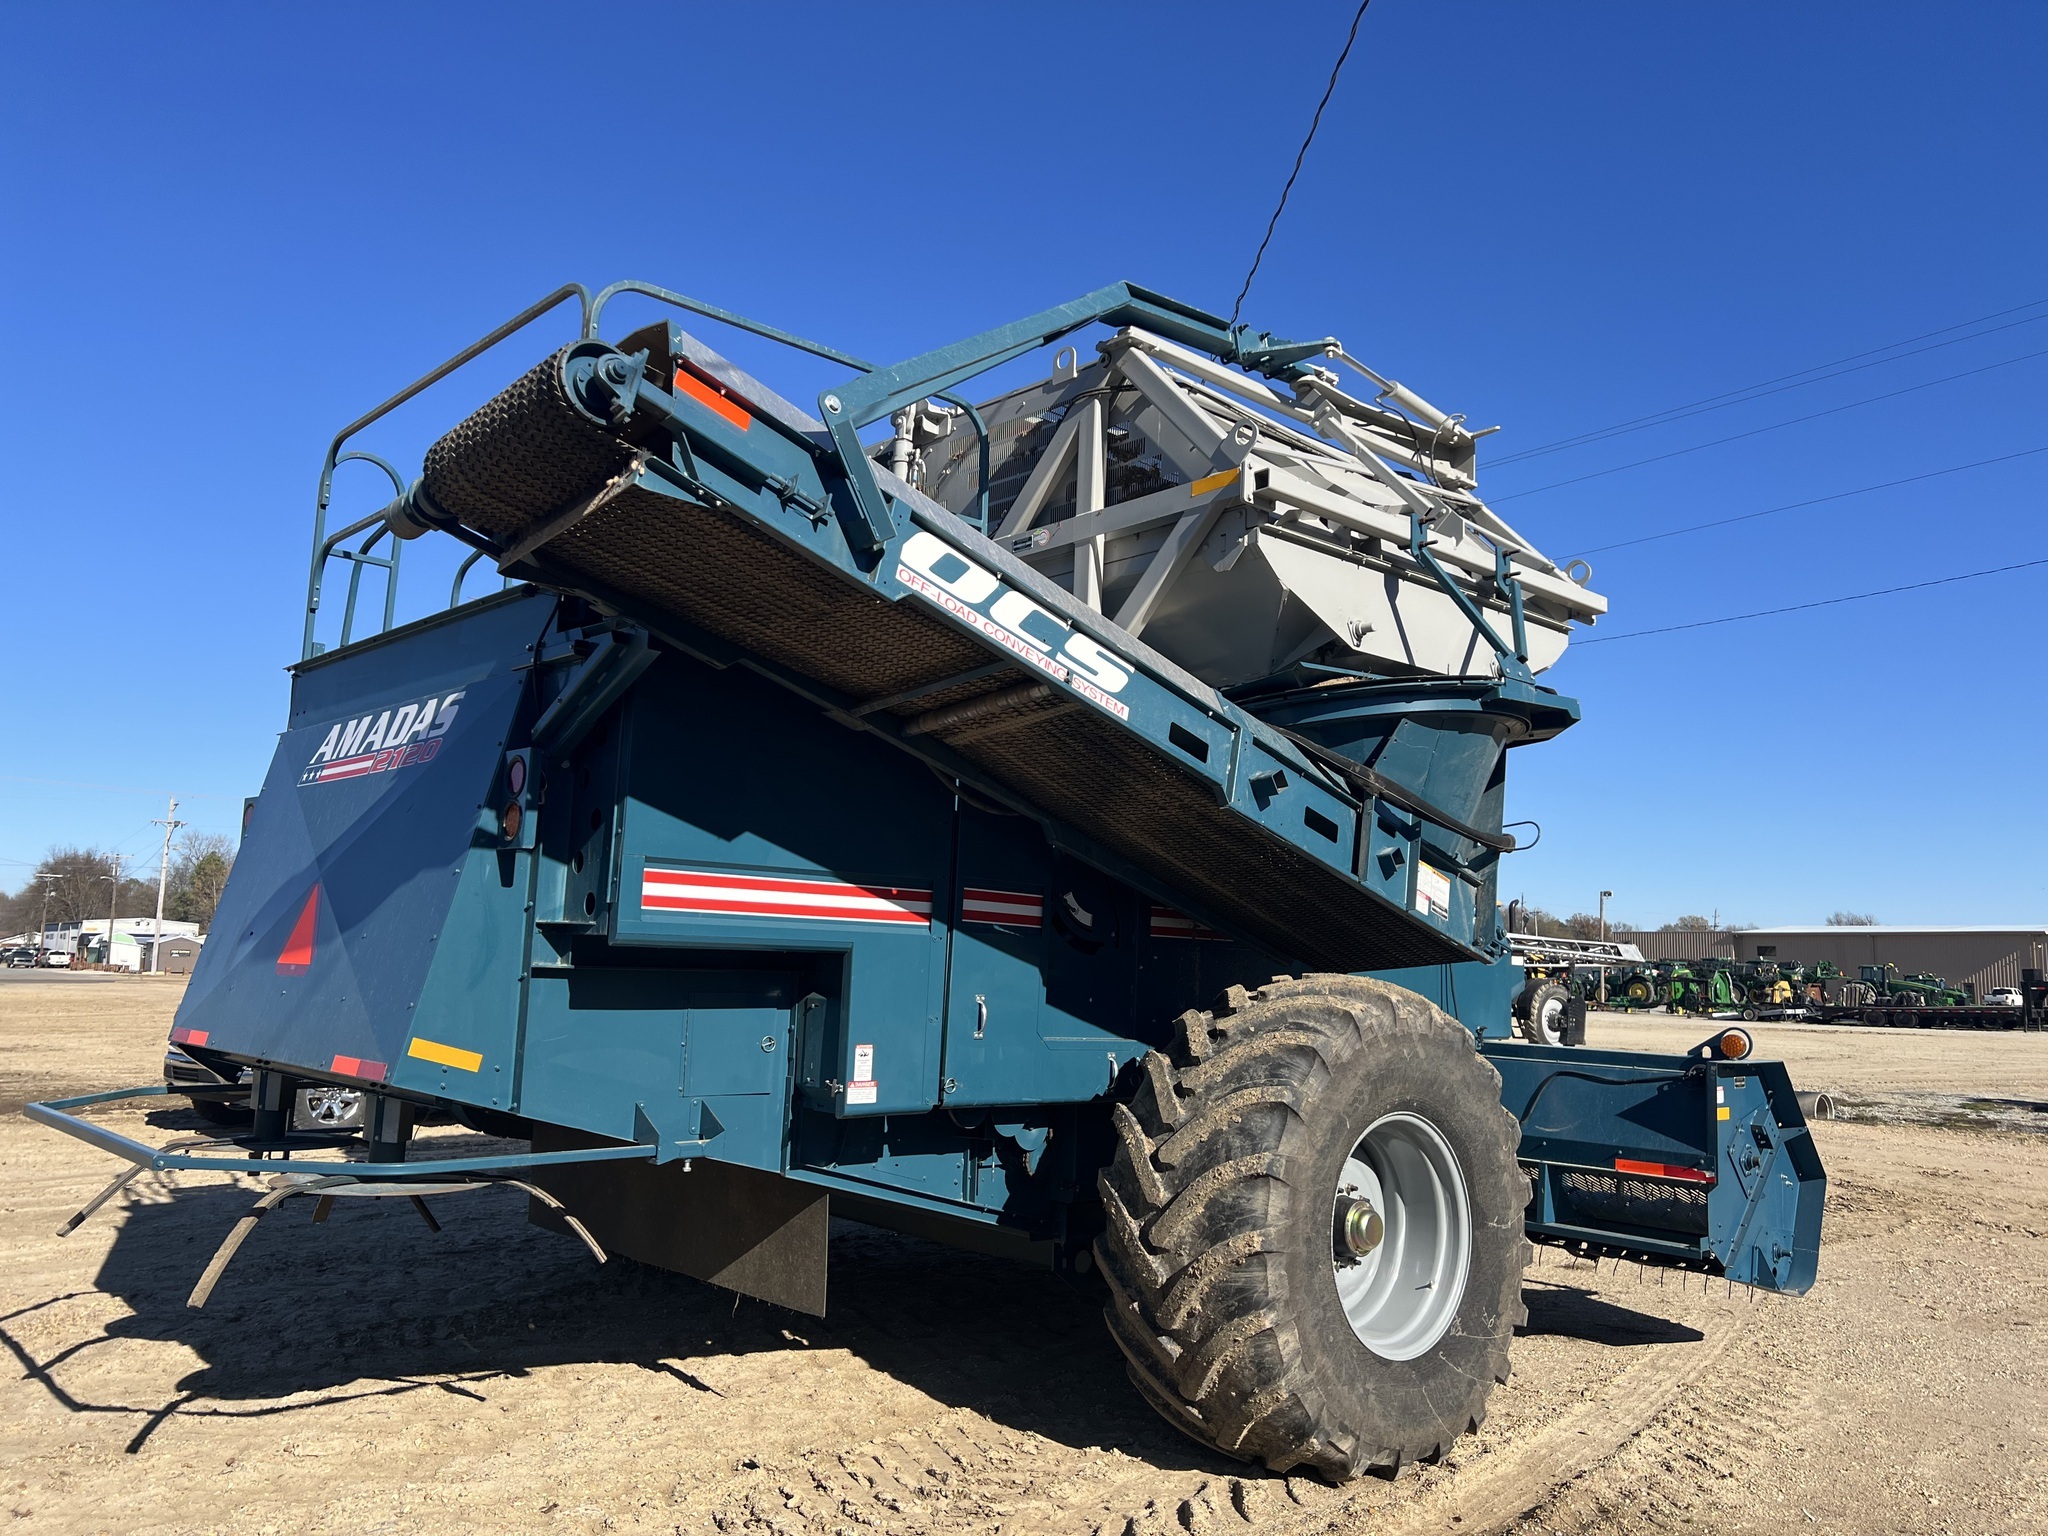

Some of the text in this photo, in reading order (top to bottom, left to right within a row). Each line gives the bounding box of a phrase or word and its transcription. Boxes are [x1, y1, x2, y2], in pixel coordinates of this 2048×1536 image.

[898, 567, 1126, 717] OFF-LOAD CONVEYING SYSTEM
[900, 531, 1136, 693] OCS
[309, 690, 467, 764] AMADAS
[369, 737, 443, 774] 2120
